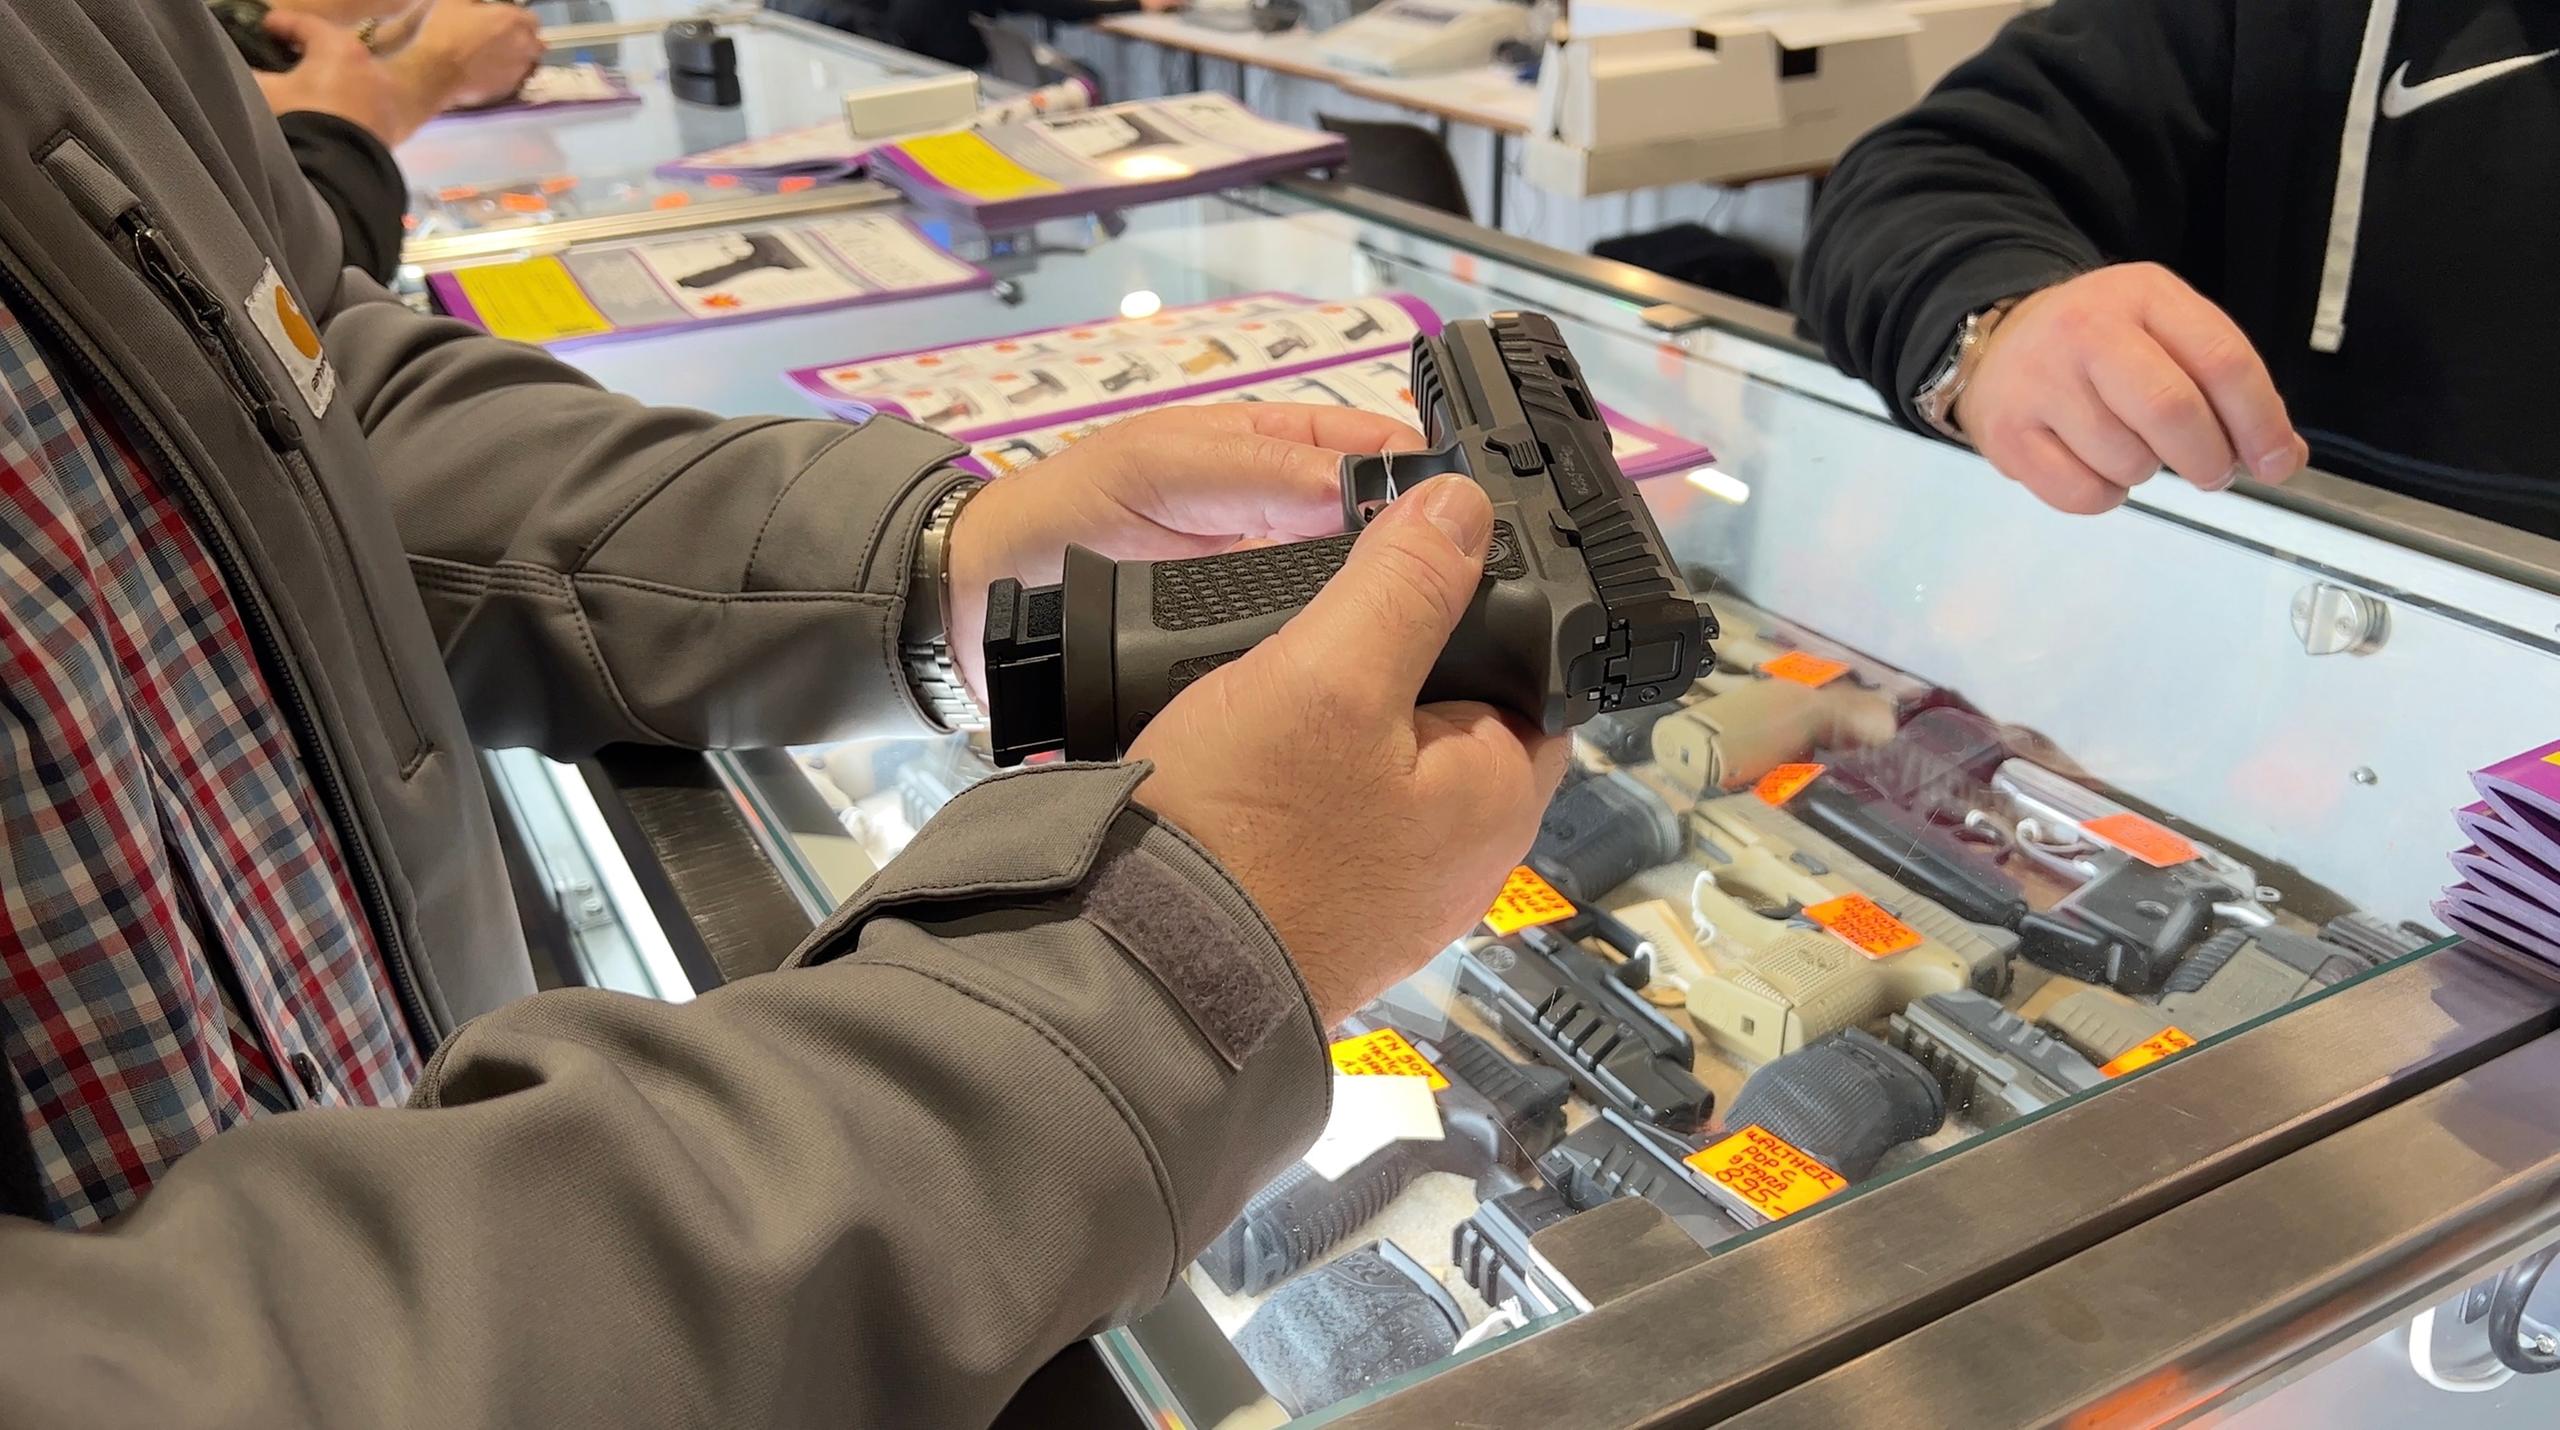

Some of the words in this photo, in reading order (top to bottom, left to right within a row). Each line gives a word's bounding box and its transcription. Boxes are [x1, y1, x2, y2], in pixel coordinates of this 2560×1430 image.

[1729, 1154, 1743, 1165] 9
[1741, 1163, 1788, 1192] PARA
[1742, 1145, 1779, 1168] PDP
[1781, 1169, 1797, 1183] C
[1746, 1130, 1834, 1190] WALTHER
